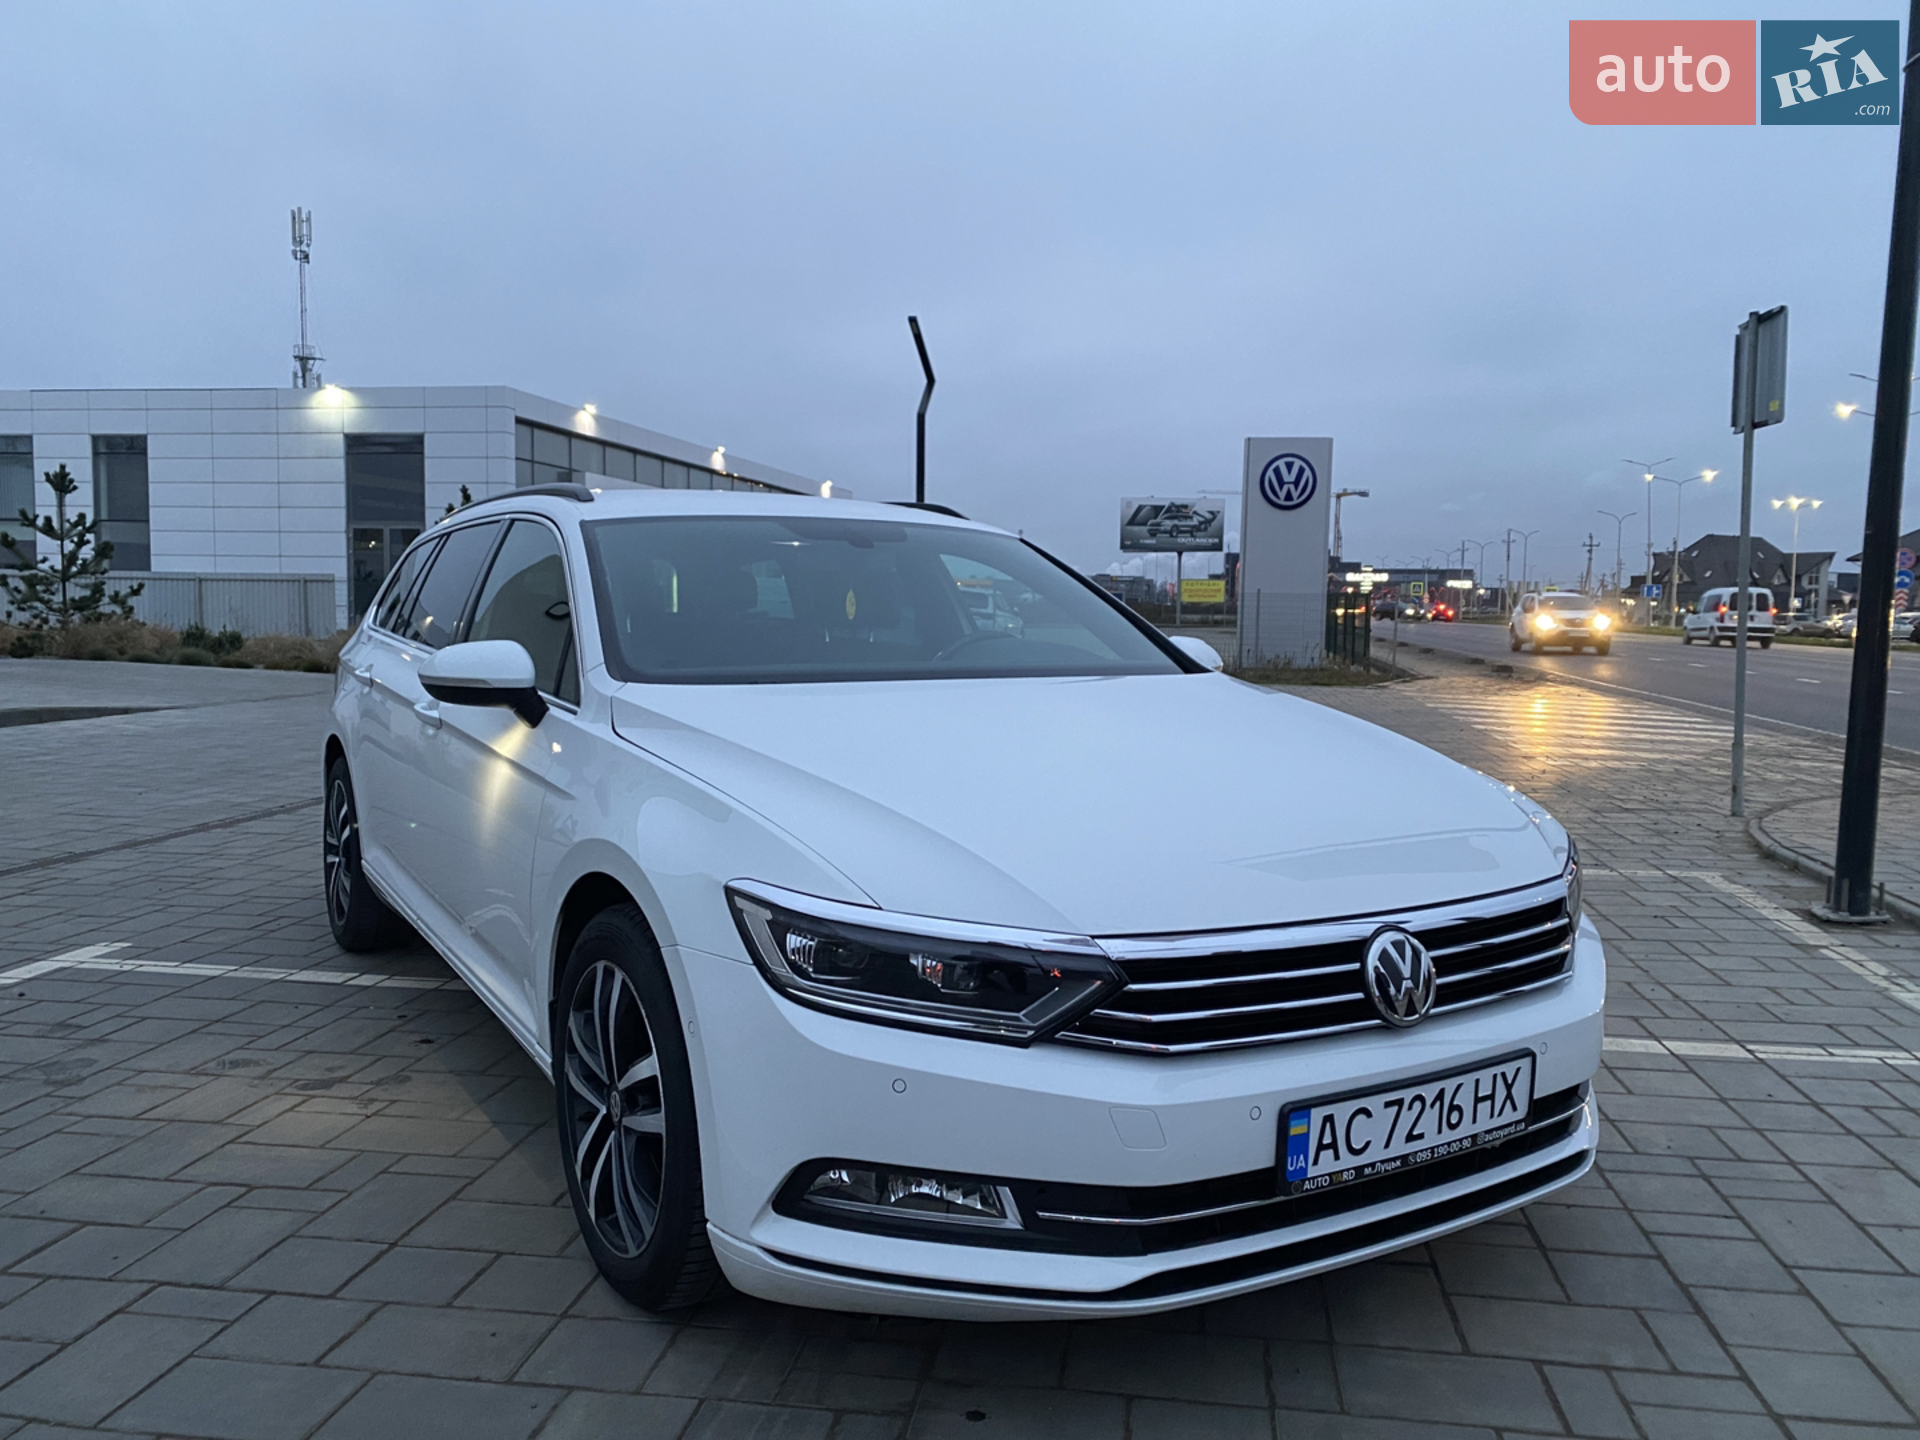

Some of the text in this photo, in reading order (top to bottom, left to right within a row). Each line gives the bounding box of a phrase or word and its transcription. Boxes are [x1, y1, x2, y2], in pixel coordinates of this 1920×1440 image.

[1312, 1066, 1522, 1166] AC 7216 HX
[1288, 1154, 1306, 1171] UA
[1303, 1169, 1356, 1191] AUTO YARD
